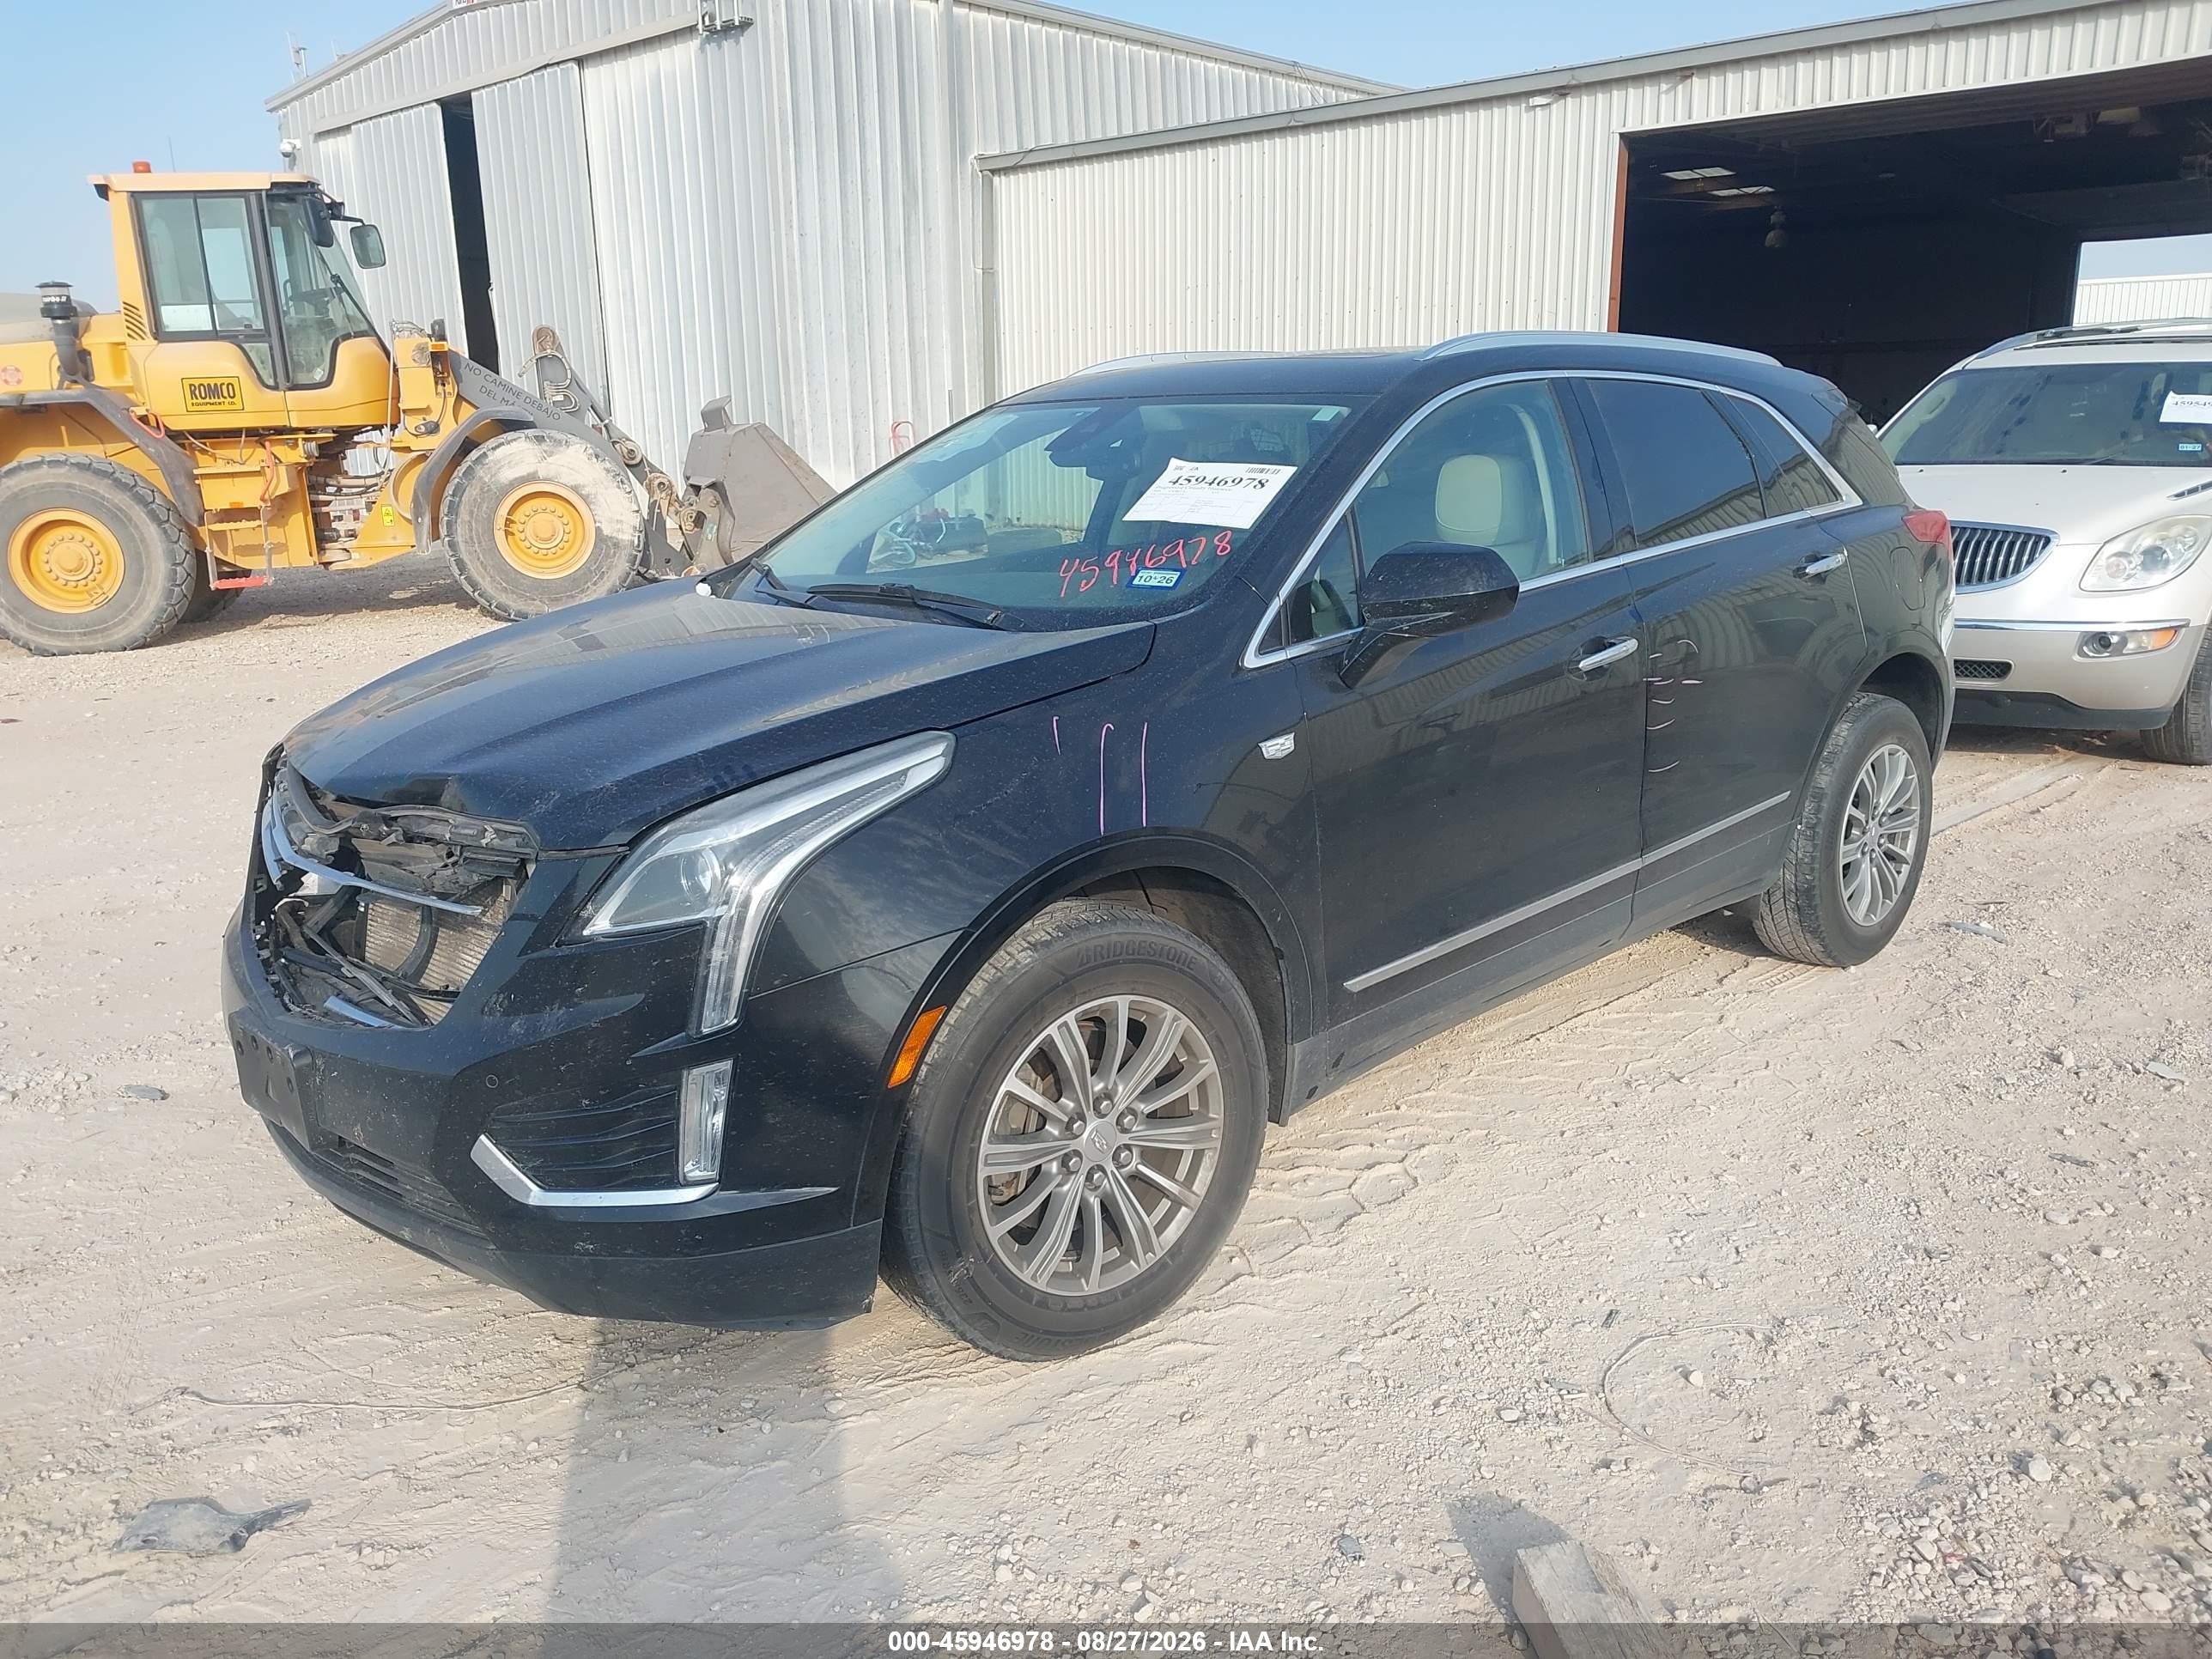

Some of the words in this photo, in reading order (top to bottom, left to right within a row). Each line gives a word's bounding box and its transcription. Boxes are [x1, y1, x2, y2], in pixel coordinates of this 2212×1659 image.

[188, 382, 236, 400] ROMCO
[464, 362, 482, 376] NO
[483, 373, 523, 400] CAMINE
[523, 395, 561, 421] DEBAJO
[479, 385, 497, 401] DEL
[1168, 475, 1270, 490] 45946978
[1059, 530, 1232, 599] 45946978
